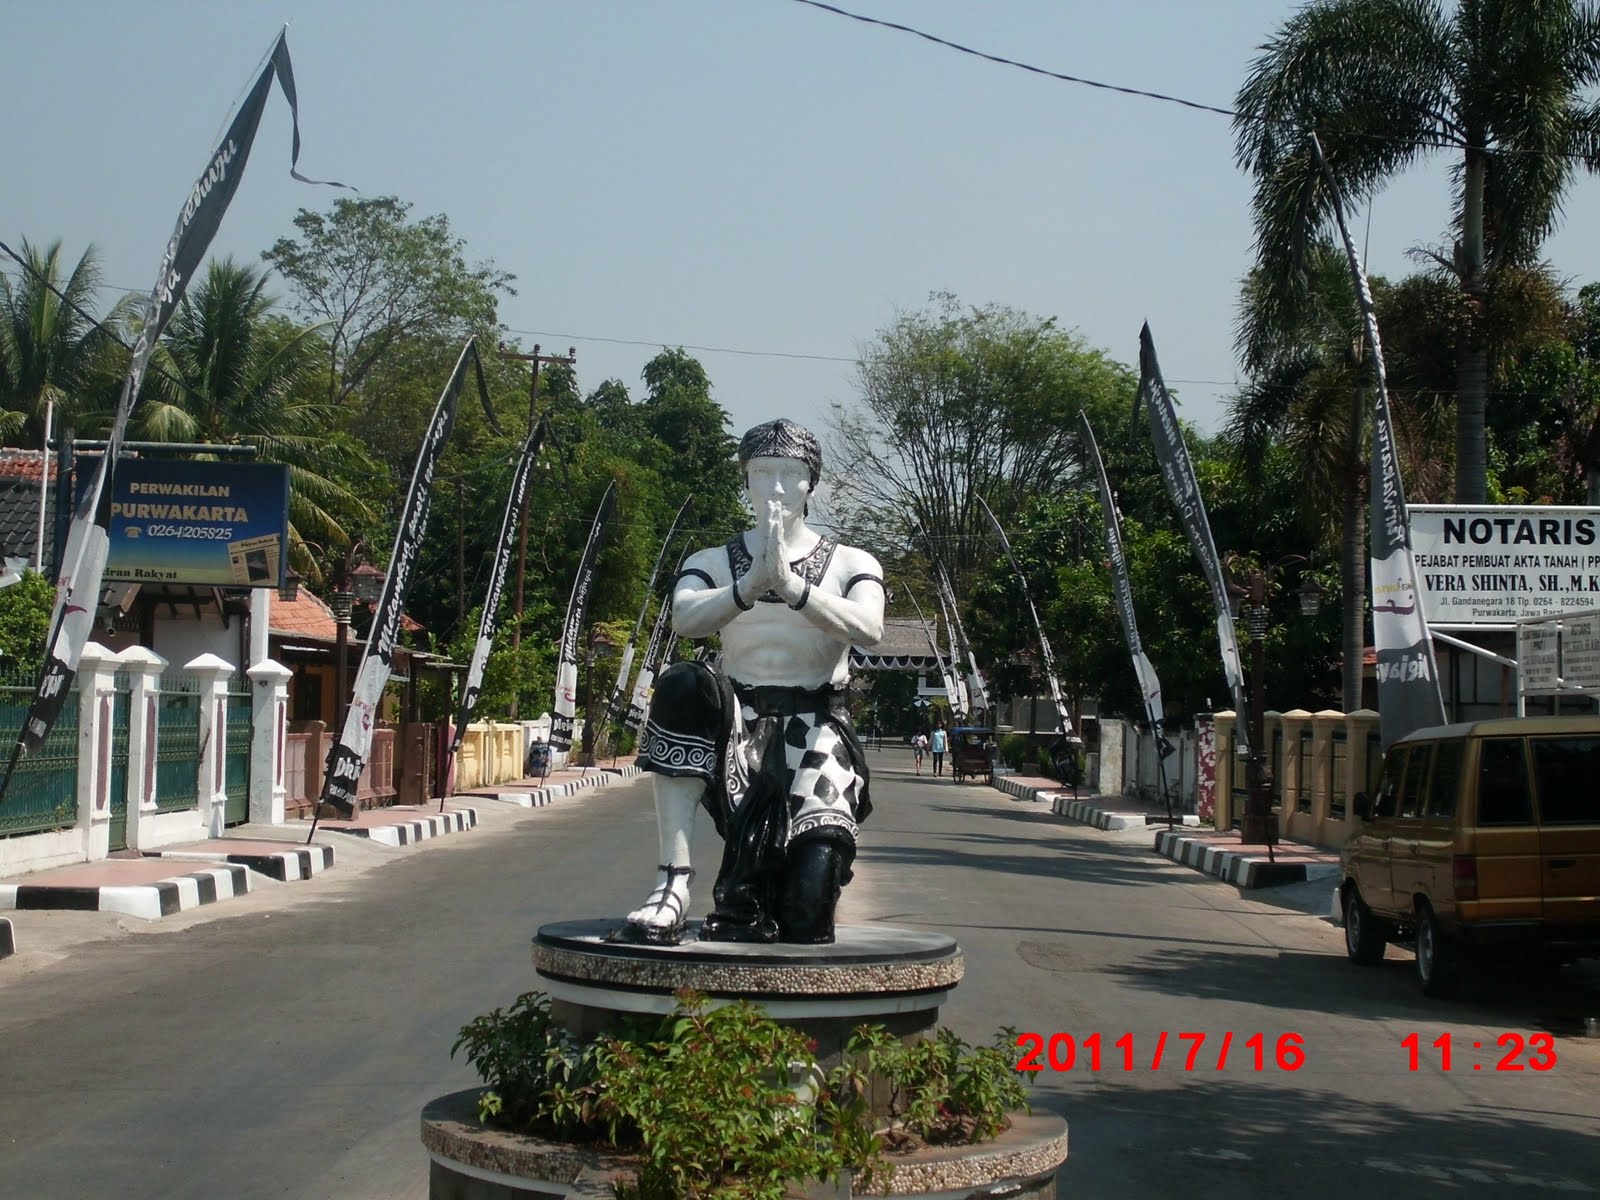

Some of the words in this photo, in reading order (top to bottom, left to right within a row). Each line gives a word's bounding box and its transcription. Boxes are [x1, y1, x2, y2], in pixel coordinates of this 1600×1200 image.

[130, 482, 230, 498] PERWAKILAN
[110, 502, 249, 523] PURWAKARTA
[1443, 517, 1596, 545] NOTARIS
[1415, 554, 1459, 568] PEJABAT
[1462, 554, 1511, 568] PEMBUAT
[1513, 555, 1541, 568] AKTA
[1544, 555, 1579, 568] TANAH
[102, 567, 131, 577] iran
[134, 568, 177, 581] Rakyat
[1425, 574, 1466, 591] VERA
[1472, 574, 1533, 594] SHINTA,
[1452, 597, 1504, 608] Gandanegara
[1506, 597, 1516, 606] 18
[1533, 597, 1553, 606] 0264
[1560, 597, 1594, 606] 8224594
[1473, 608, 1519, 618] Purwakarta,
[1520, 608, 1541, 617] Jawa
